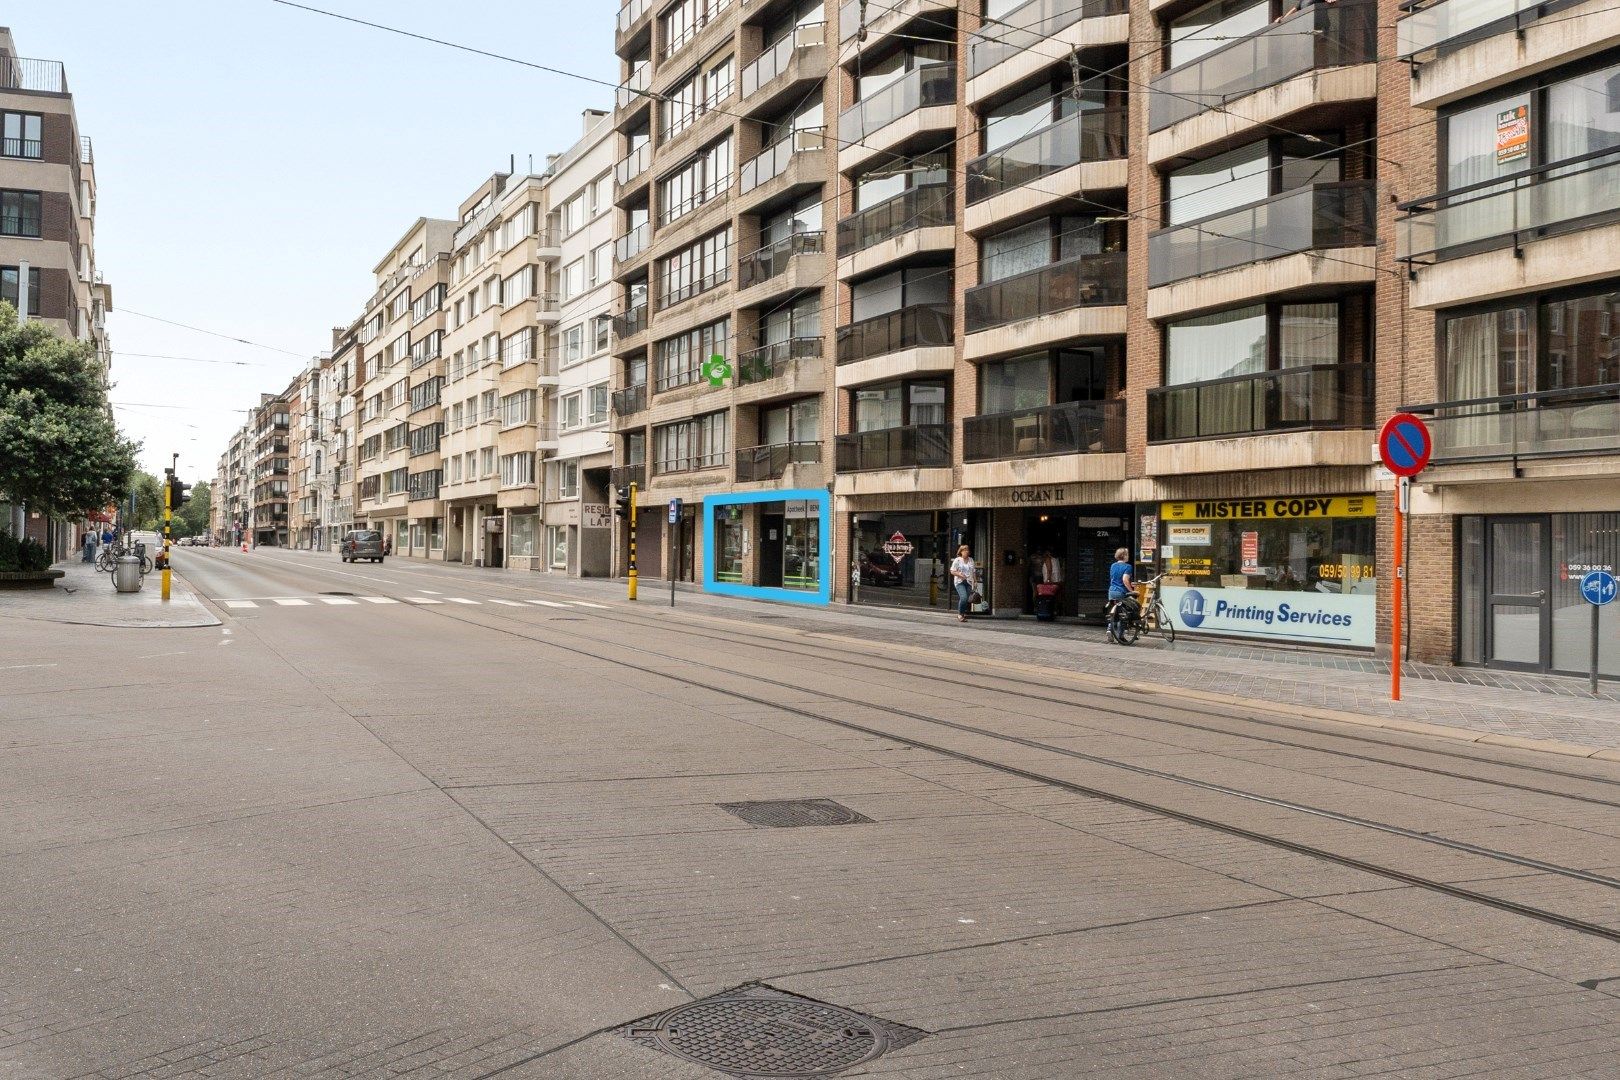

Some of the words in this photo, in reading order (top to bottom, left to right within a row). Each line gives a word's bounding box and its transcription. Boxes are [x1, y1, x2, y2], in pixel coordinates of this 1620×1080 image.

[1498, 111, 1515, 124] Luk
[1012, 490, 1051, 502] OCEAN
[1055, 489, 1064, 500] II
[584, 505, 611, 514] RESID
[787, 505, 804, 513] Apotheek
[1196, 501, 1266, 518] MISTER
[1274, 499, 1332, 517] COPY
[1319, 564, 1347, 578] 059/50
[1350, 565, 1361, 578] 99
[1363, 565, 1374, 578] 81
[1181, 598, 1212, 616] ALL
[1215, 600, 1275, 624] Printing
[1277, 603, 1352, 627] Services
